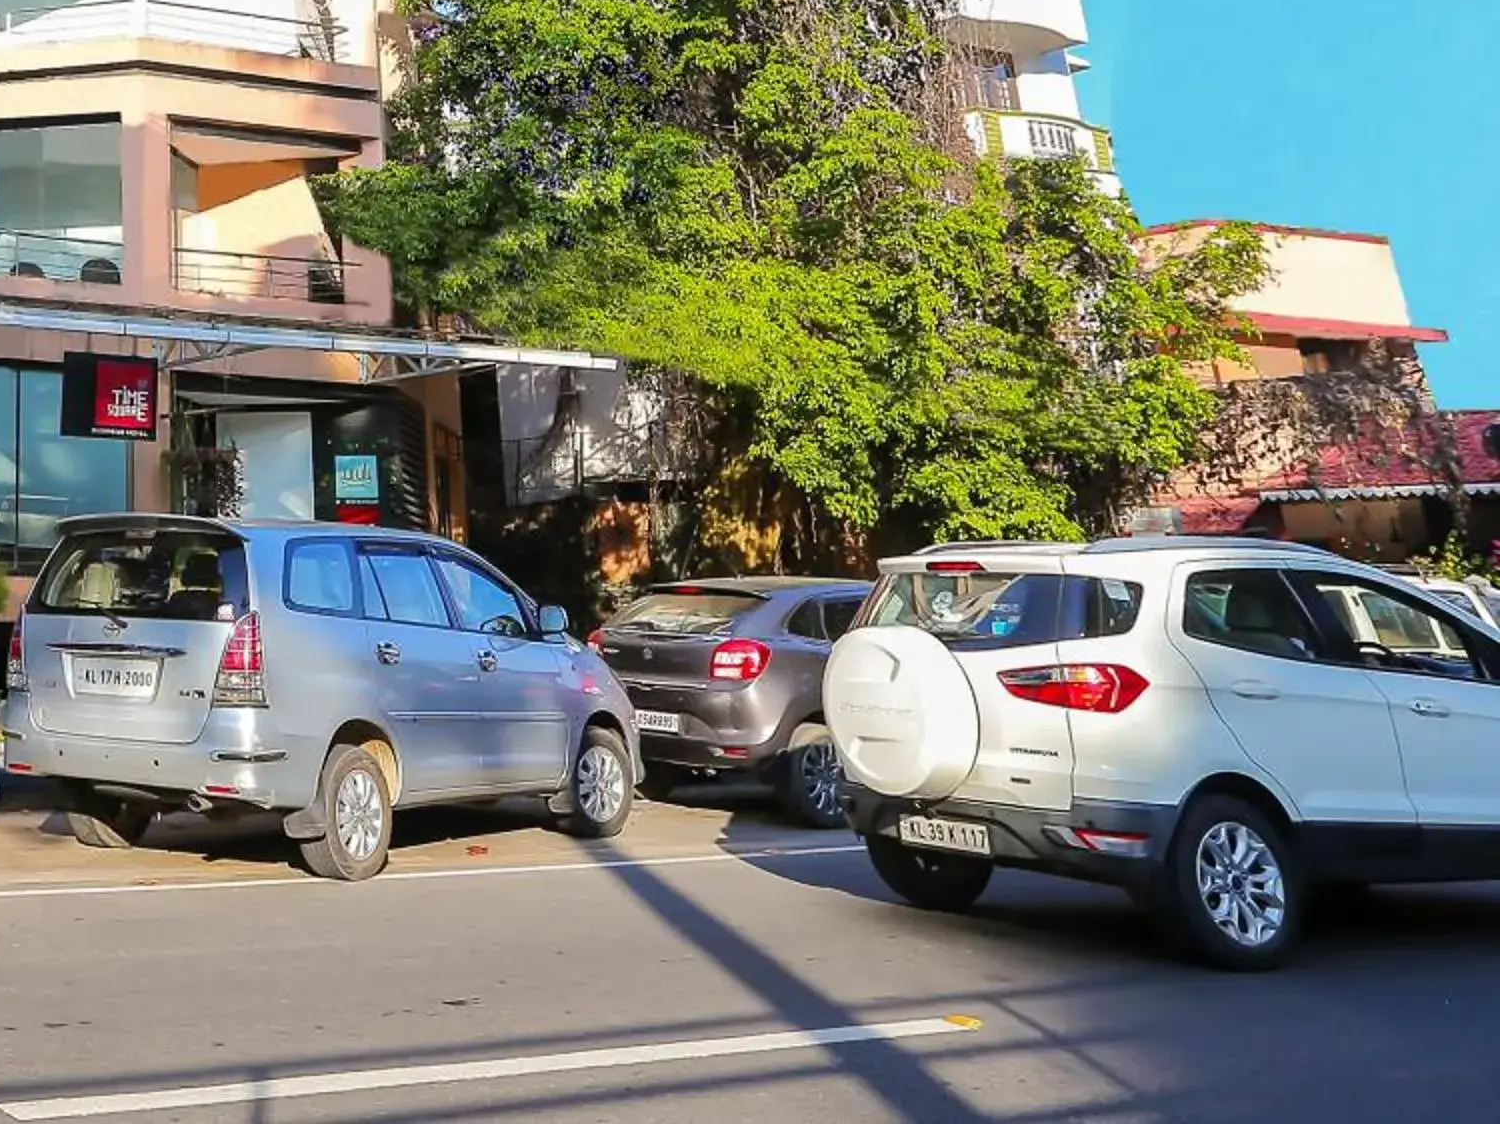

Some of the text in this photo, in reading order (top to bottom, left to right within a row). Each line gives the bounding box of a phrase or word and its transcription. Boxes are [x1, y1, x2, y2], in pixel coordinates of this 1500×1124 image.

[112, 385, 149, 406] TIME
[909, 820, 925, 839] KL
[947, 824, 957, 844] K
[961, 827, 985, 848] 117
